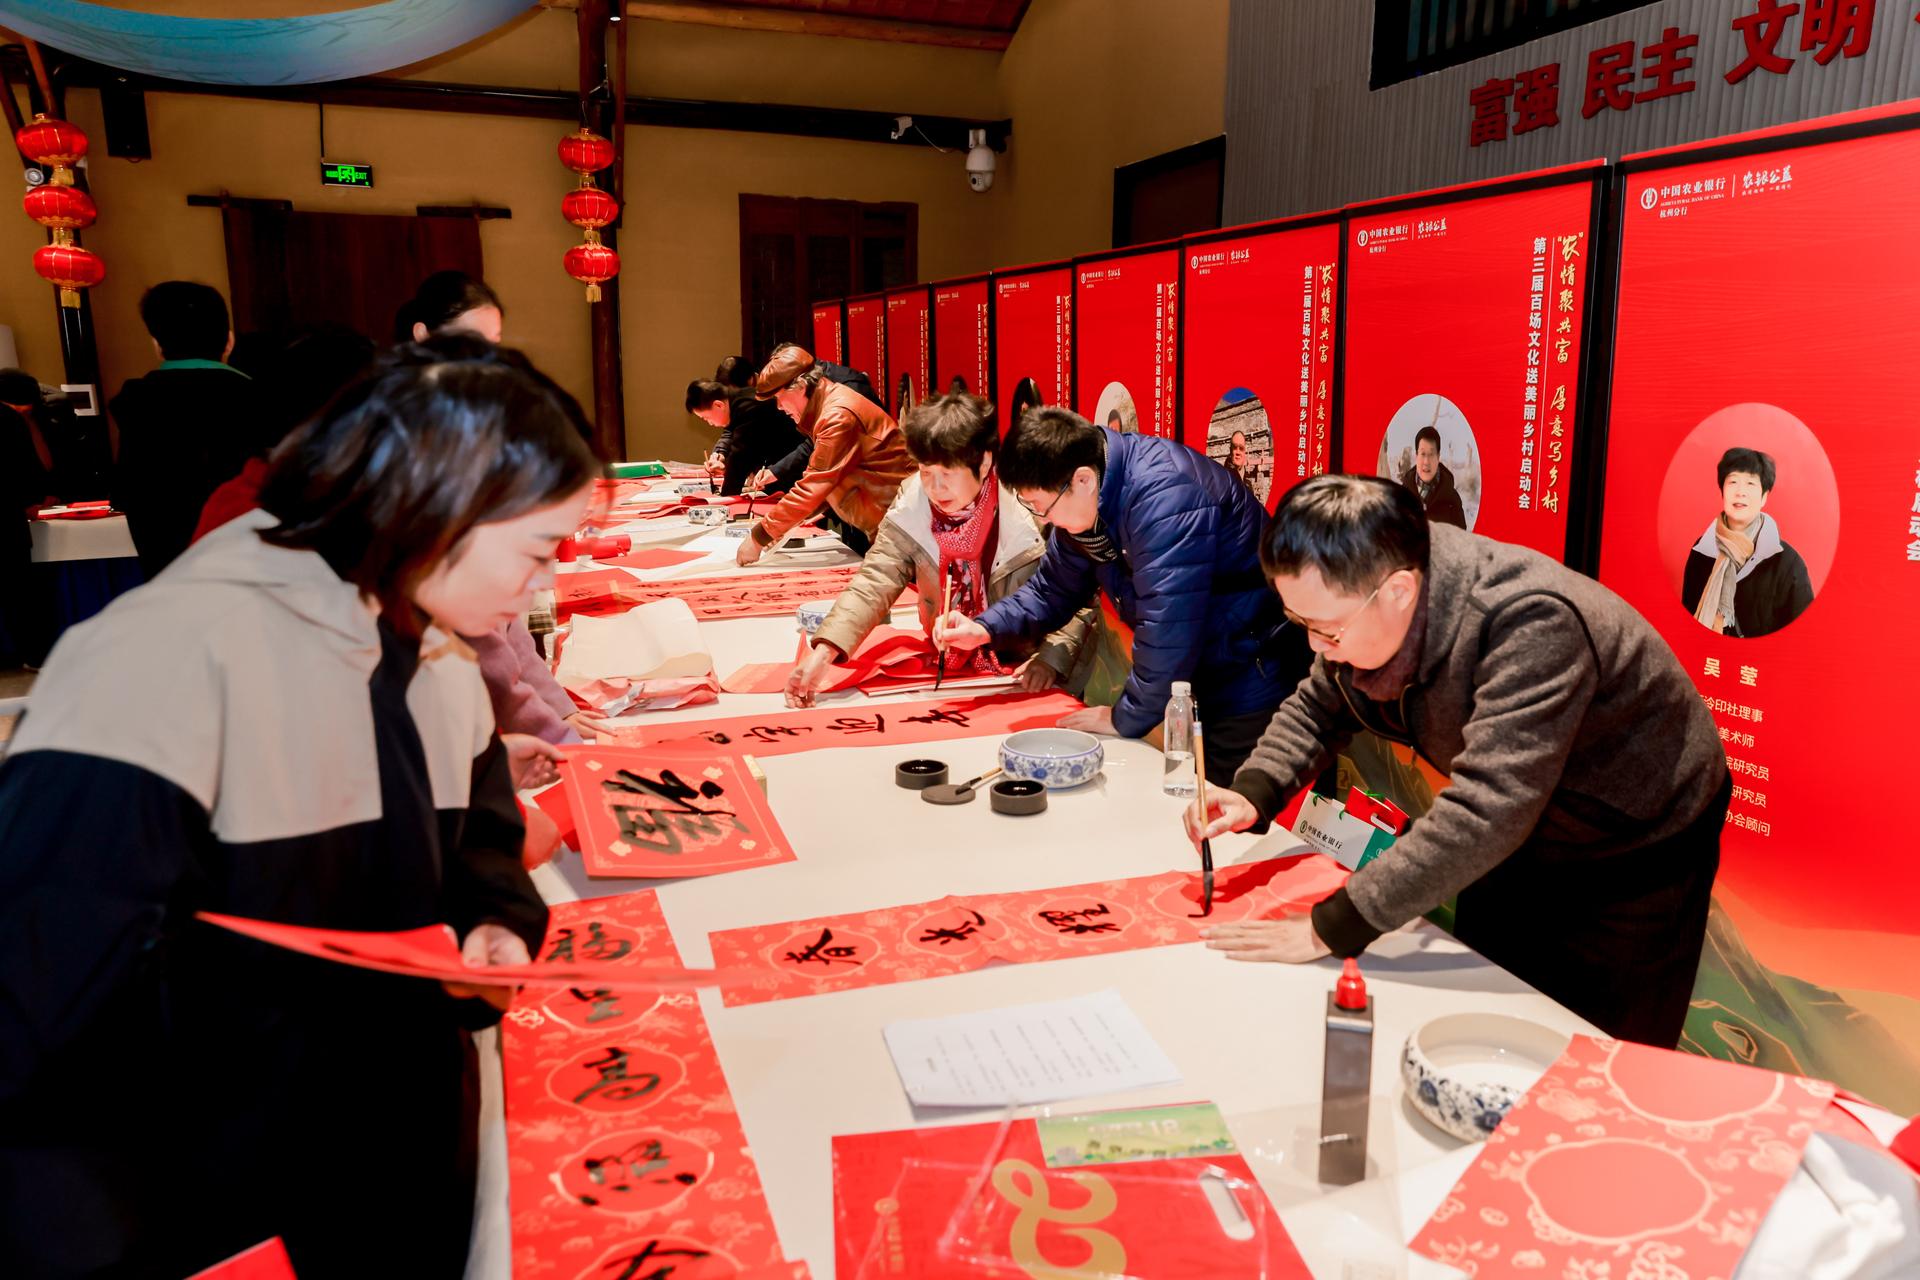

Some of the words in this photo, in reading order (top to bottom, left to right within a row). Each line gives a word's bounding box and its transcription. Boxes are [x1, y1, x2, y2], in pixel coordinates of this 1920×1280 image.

[1469, 63, 1560, 147] 富强
[1581, 27, 1698, 119] 民主
[1724, 0, 1876, 85] 文明
[355, 172, 368, 180] EXIT
[1660, 178, 1725, 198] 中国农业银行
[1743, 165, 1792, 188] 农银公益
[1659, 206, 1688, 219] 杭州分行
[1369, 225, 1408, 238] 中国农业银行
[1518, 236, 1548, 510] 第三届百场文化送美丽乡村启动会
[1541, 384, 1566, 514] 厚意写乡村
[1700, 695, 1763, 723] 泠印社理事
